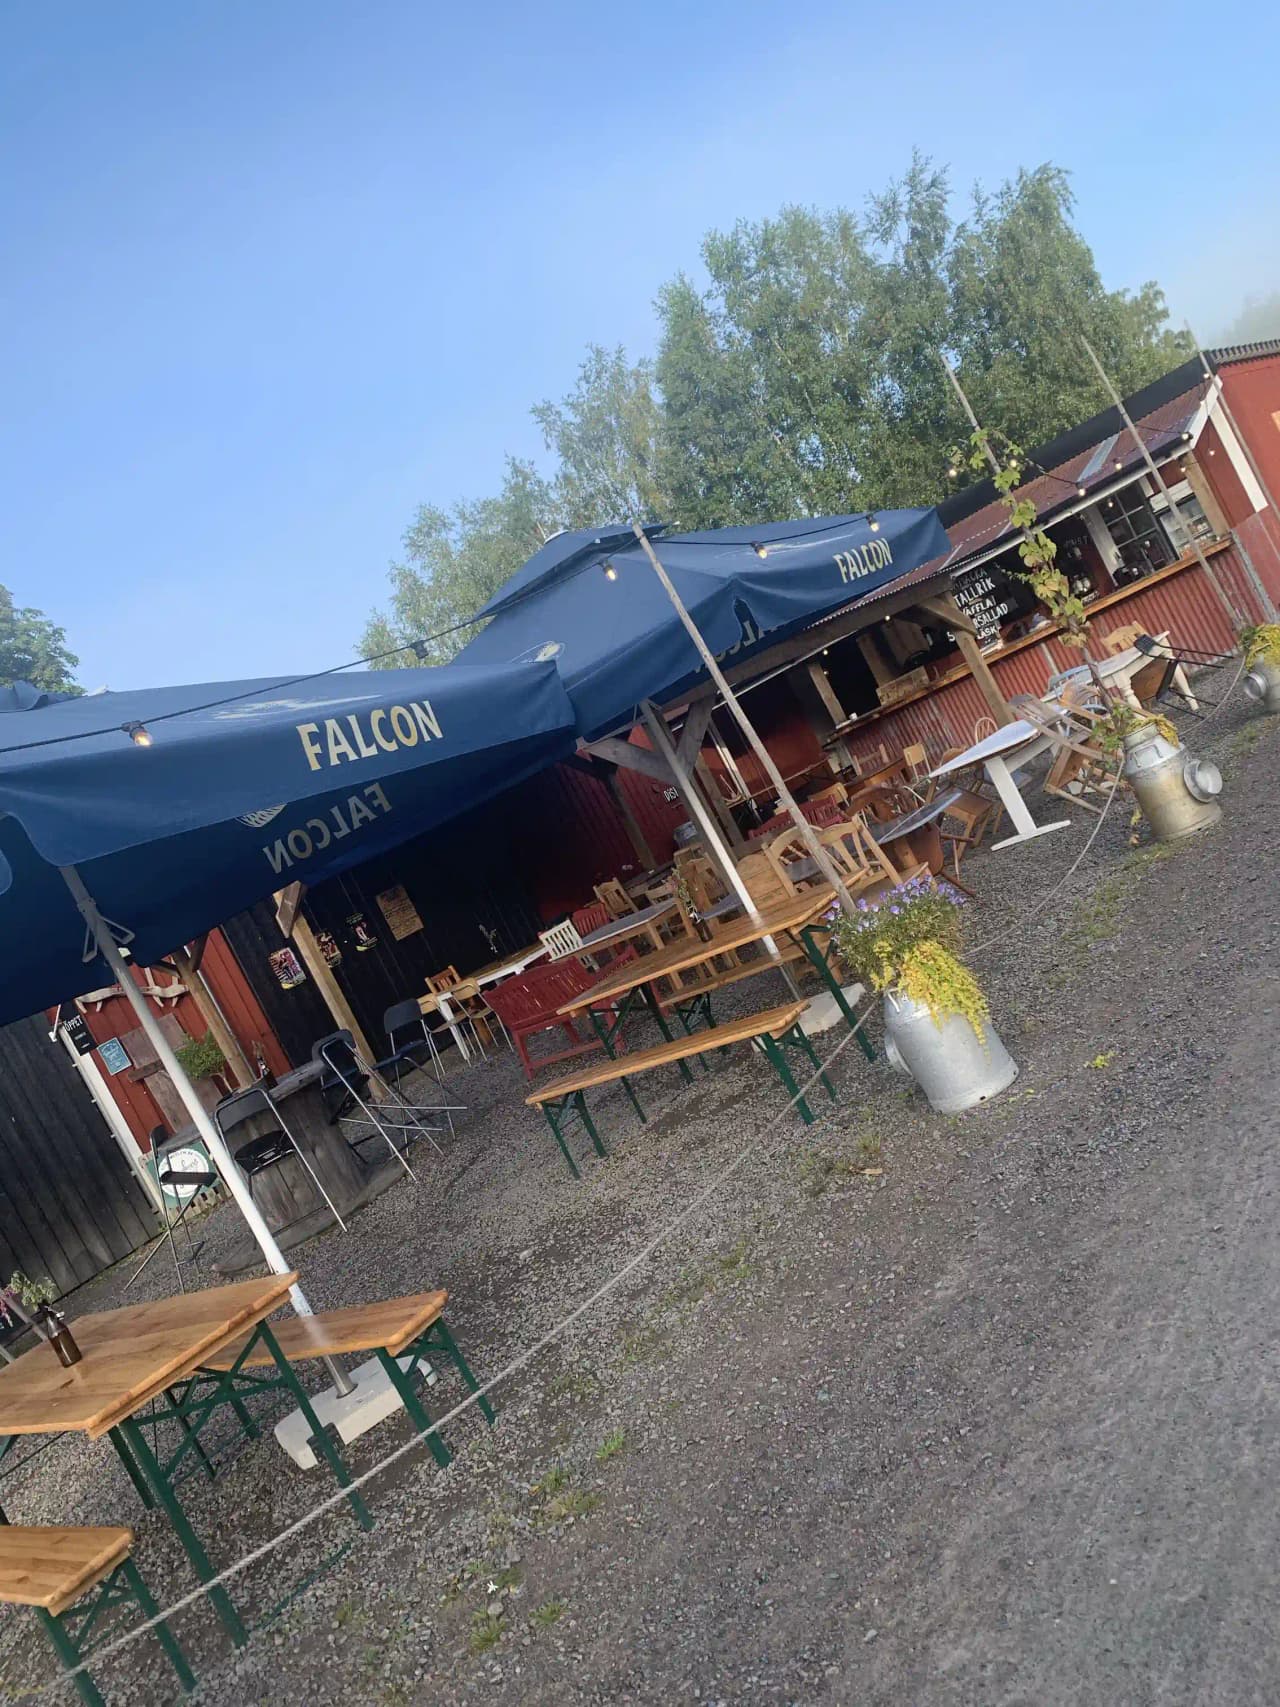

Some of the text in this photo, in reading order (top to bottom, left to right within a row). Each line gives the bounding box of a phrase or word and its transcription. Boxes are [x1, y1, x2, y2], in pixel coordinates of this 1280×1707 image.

[832, 537, 893, 583] FALCON
[954, 577, 996, 607] TALLRIK
[296, 700, 444, 771] FALCON
